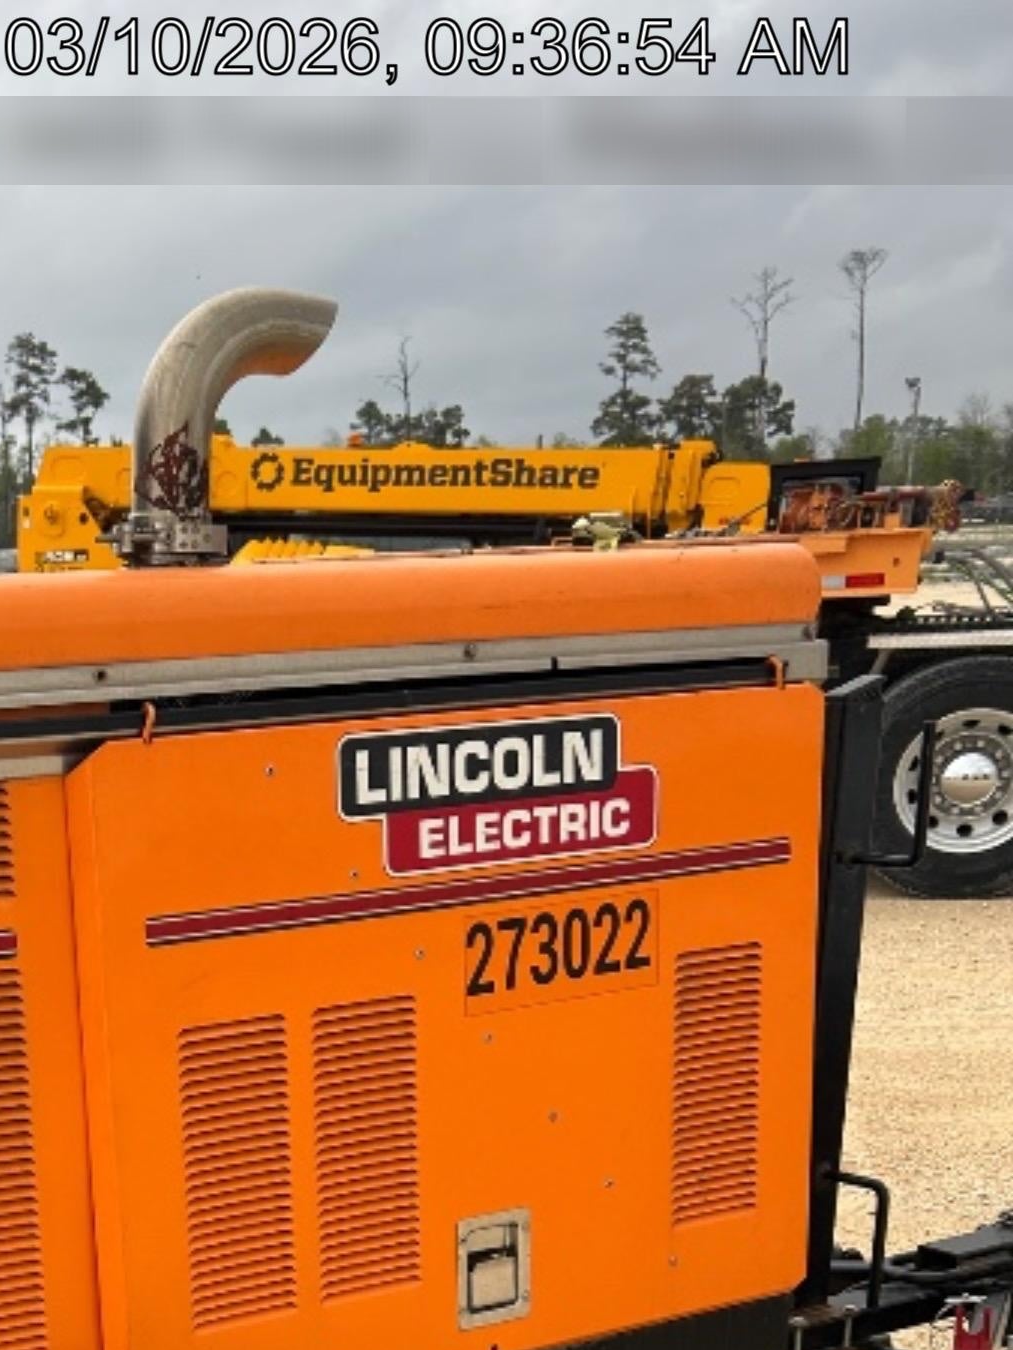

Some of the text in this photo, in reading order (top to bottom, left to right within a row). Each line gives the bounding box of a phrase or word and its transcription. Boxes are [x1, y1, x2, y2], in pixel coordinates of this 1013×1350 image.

[291, 457, 601, 492] EquipmentShare
[354, 728, 604, 805] LINCOLN
[418, 797, 631, 860] ELECTRIC
[465, 898, 652, 998] 273022
